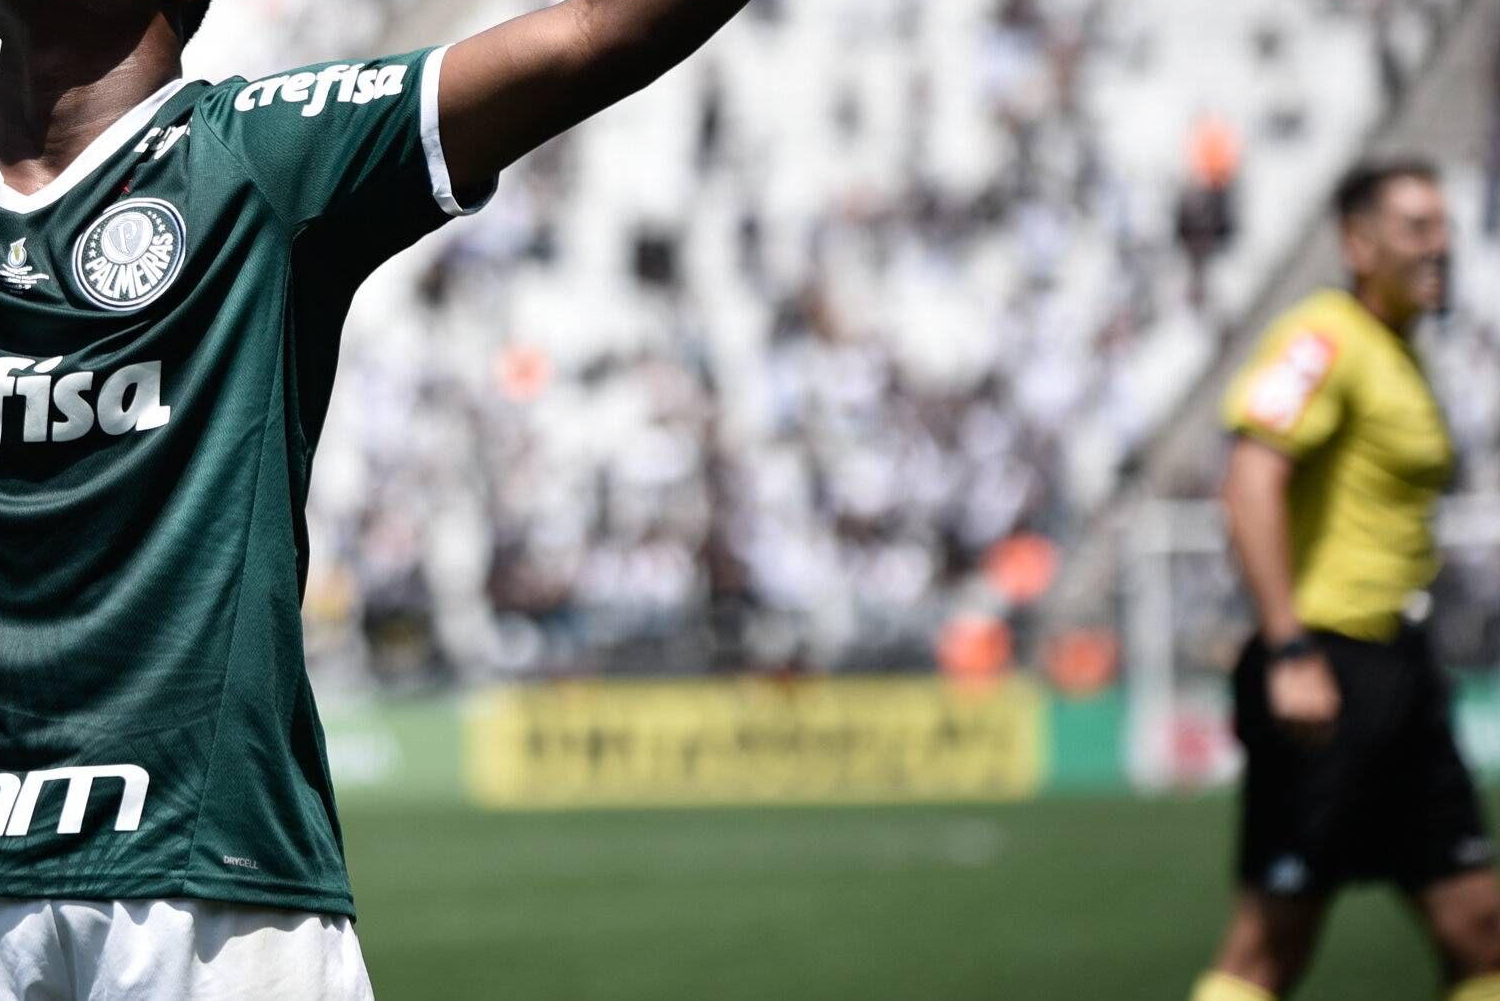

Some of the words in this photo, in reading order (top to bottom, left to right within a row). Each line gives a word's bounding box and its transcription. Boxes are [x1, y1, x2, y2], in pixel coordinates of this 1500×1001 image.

[234, 63, 408, 117] crefisa
[85, 232, 174, 299] PALMEIRAS
[223, 855, 259, 869] DRYCELL
